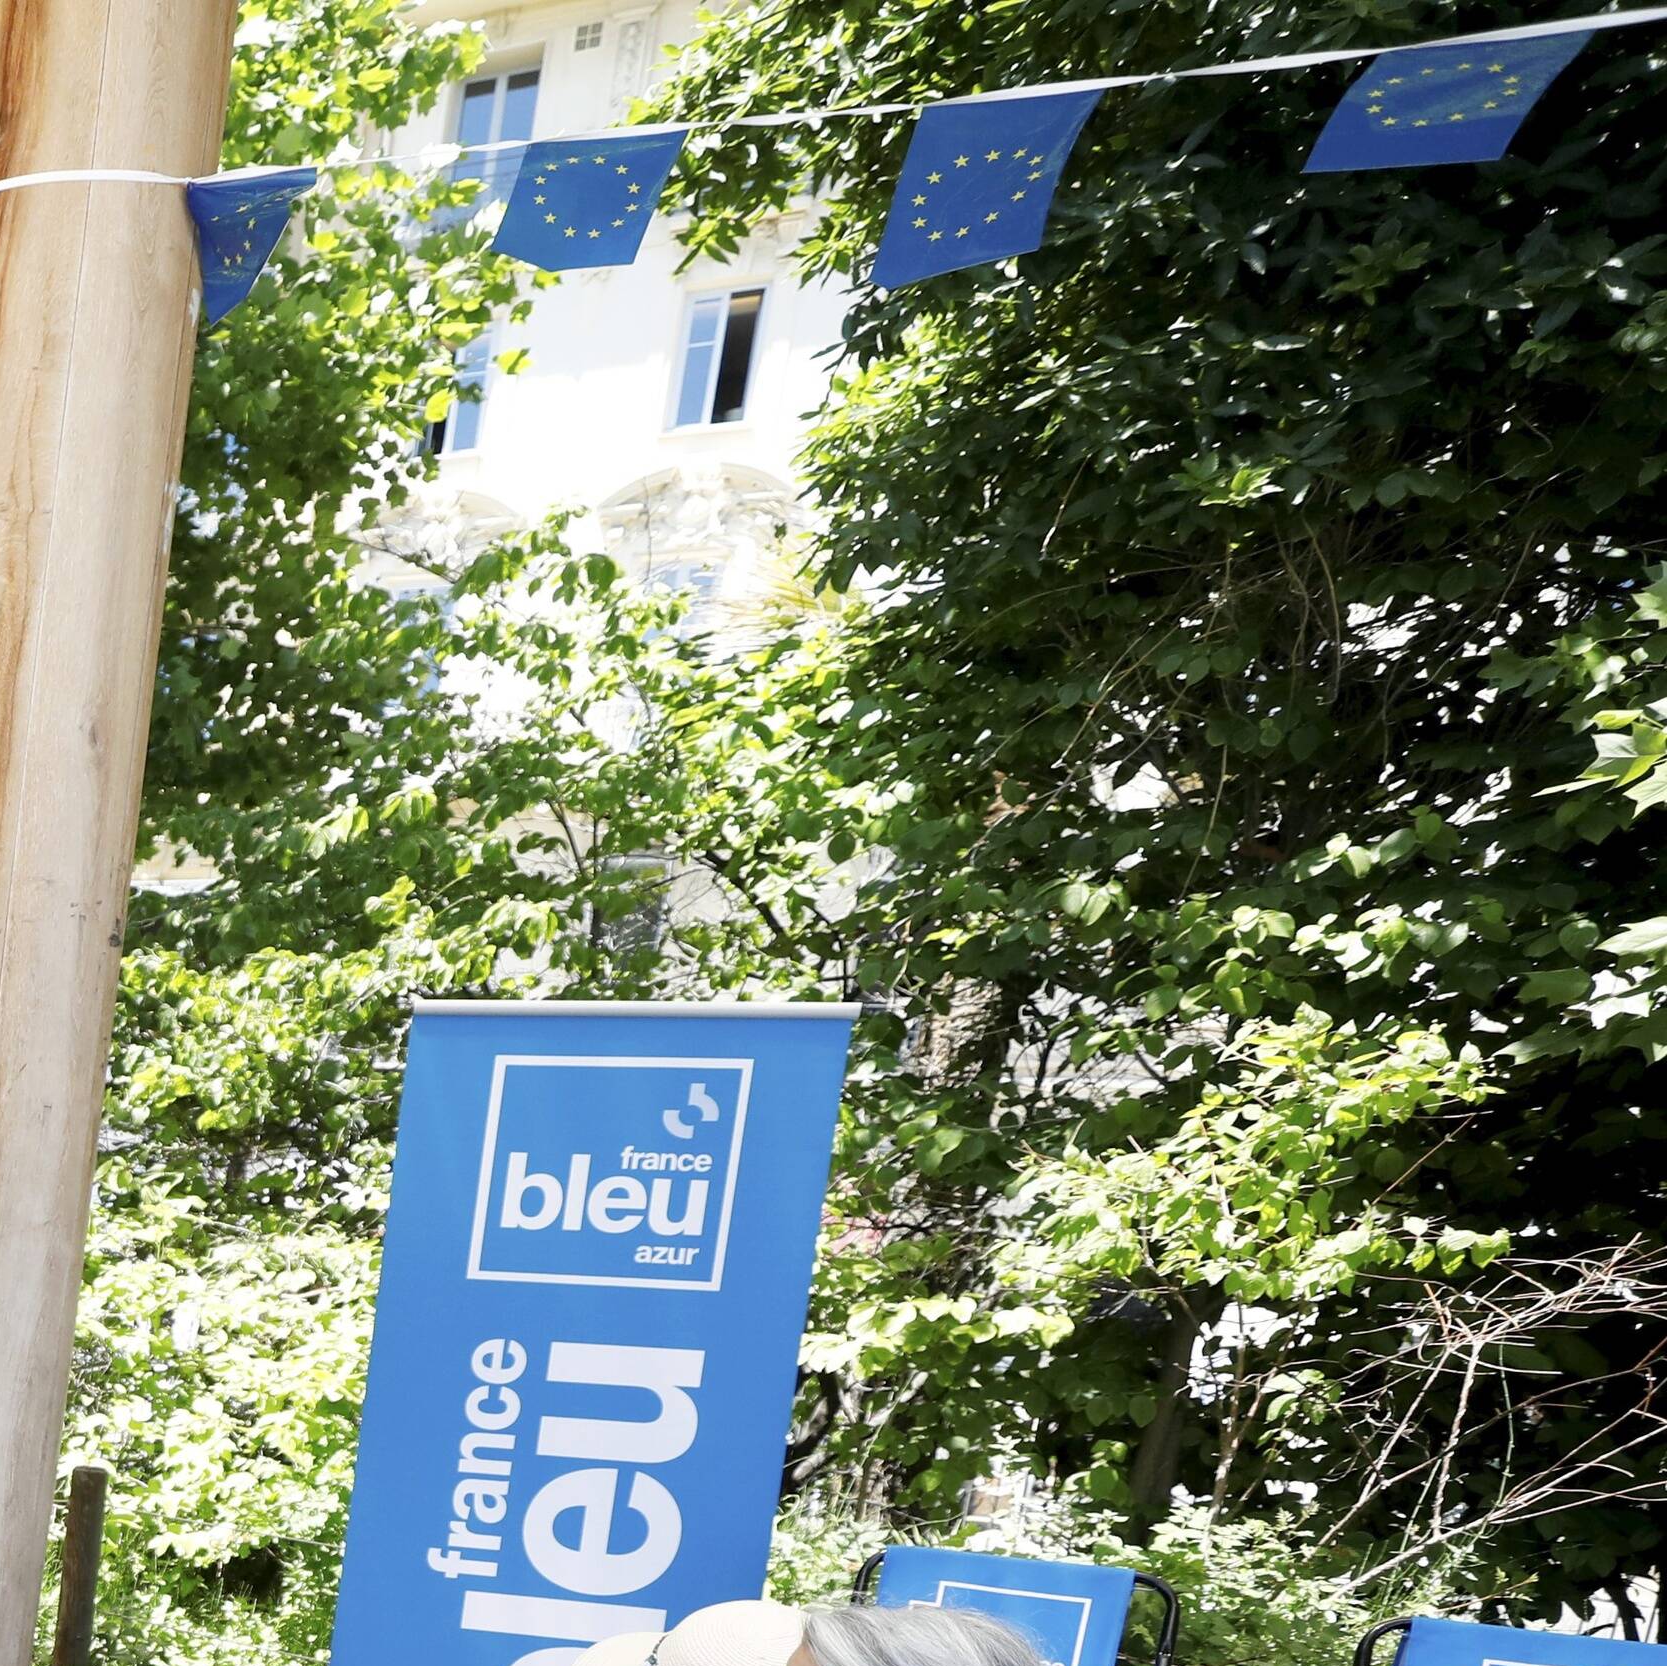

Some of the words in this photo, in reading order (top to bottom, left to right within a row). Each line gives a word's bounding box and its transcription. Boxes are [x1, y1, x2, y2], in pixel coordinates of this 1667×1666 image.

[620, 1145, 713, 1173] france
[500, 1151, 710, 1237] bleu
[634, 1244, 700, 1265] azur
[427, 1338, 528, 1579] france
